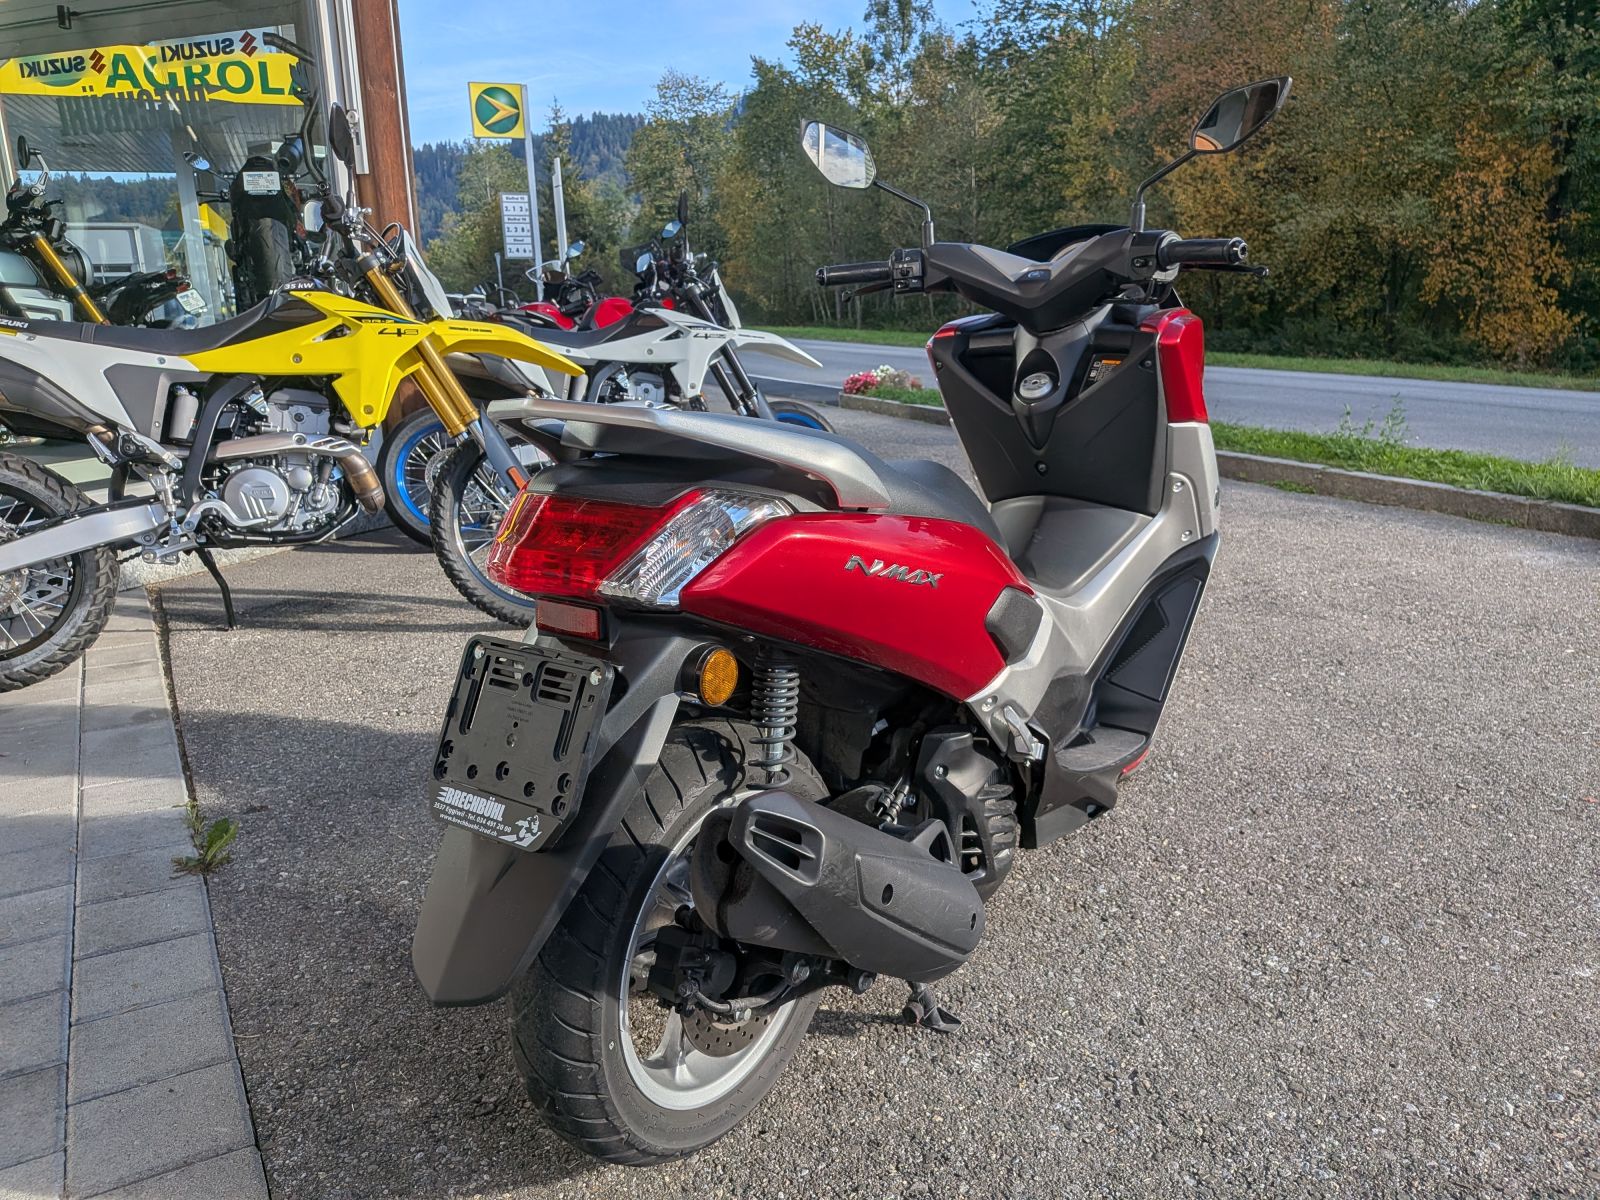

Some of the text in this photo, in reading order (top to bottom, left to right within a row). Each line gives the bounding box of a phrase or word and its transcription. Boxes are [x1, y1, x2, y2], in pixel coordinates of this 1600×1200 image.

[105, 53, 296, 95] AGROL
[845, 555, 944, 588] NMAX
[433, 801, 447, 811] 3537
[445, 806, 466, 817] Eggiwil
[467, 813, 477, 822] Tel.
[476, 816, 487, 825] 034
[496, 823, 505, 831] 20
[503, 825, 512, 833] 00
[445, 787, 506, 821] BRECHBÜHL
